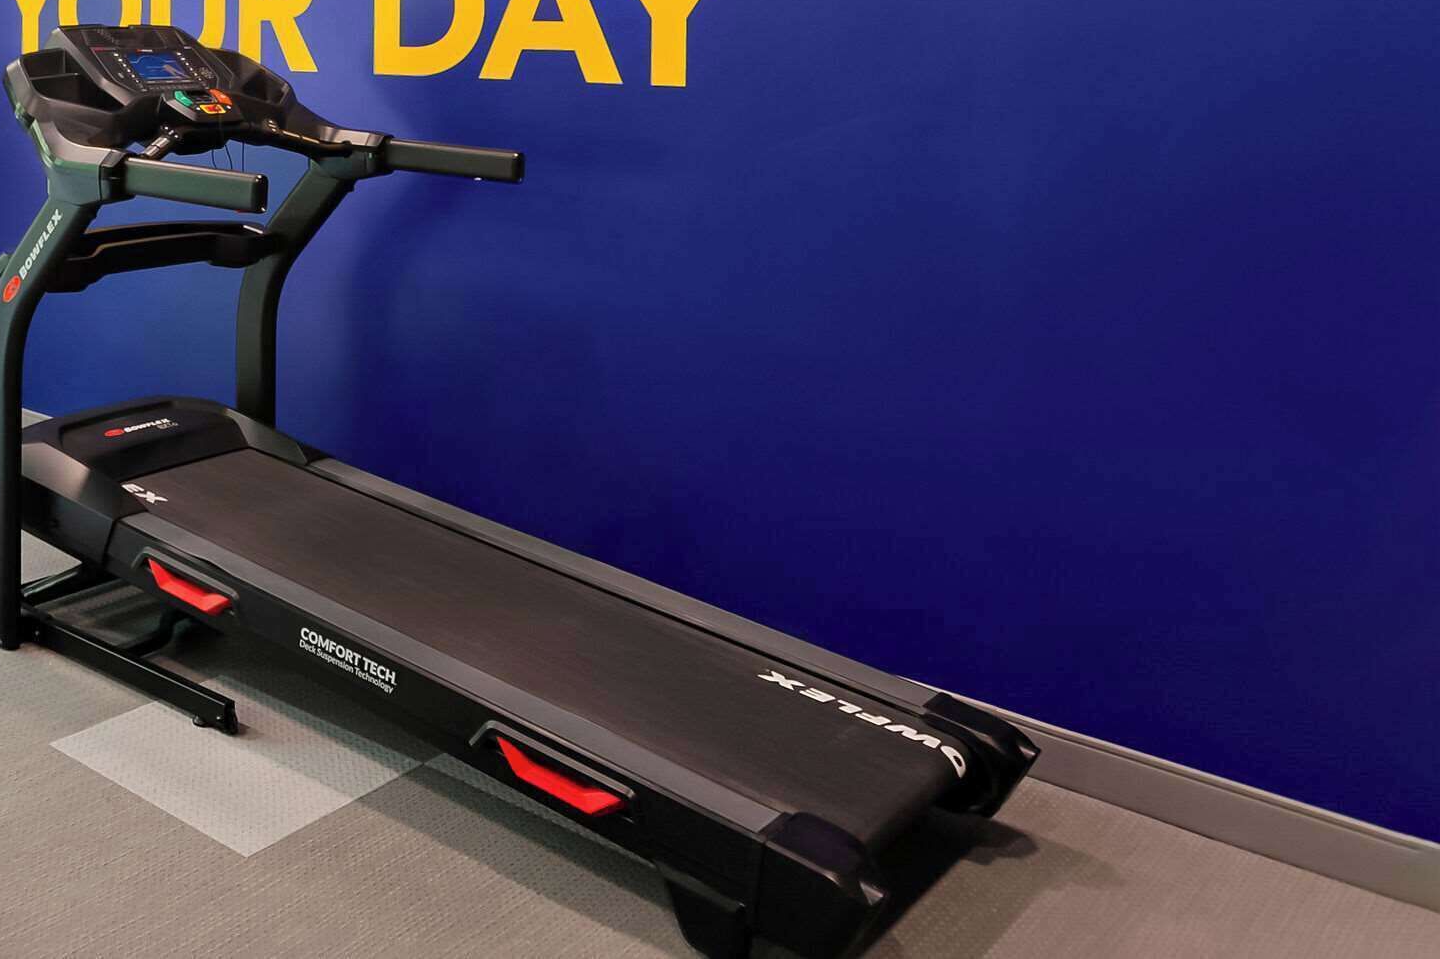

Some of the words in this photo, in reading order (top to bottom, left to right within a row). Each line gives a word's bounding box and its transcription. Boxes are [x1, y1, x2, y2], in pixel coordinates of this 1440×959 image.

[18, 208, 63, 281] BOWFLEX
[299, 639, 317, 655] Deck
[316, 648, 355, 674] Suspension
[355, 666, 395, 695] Technology
[300, 627, 362, 666] COMFORT
[362, 656, 397, 686] TECH
